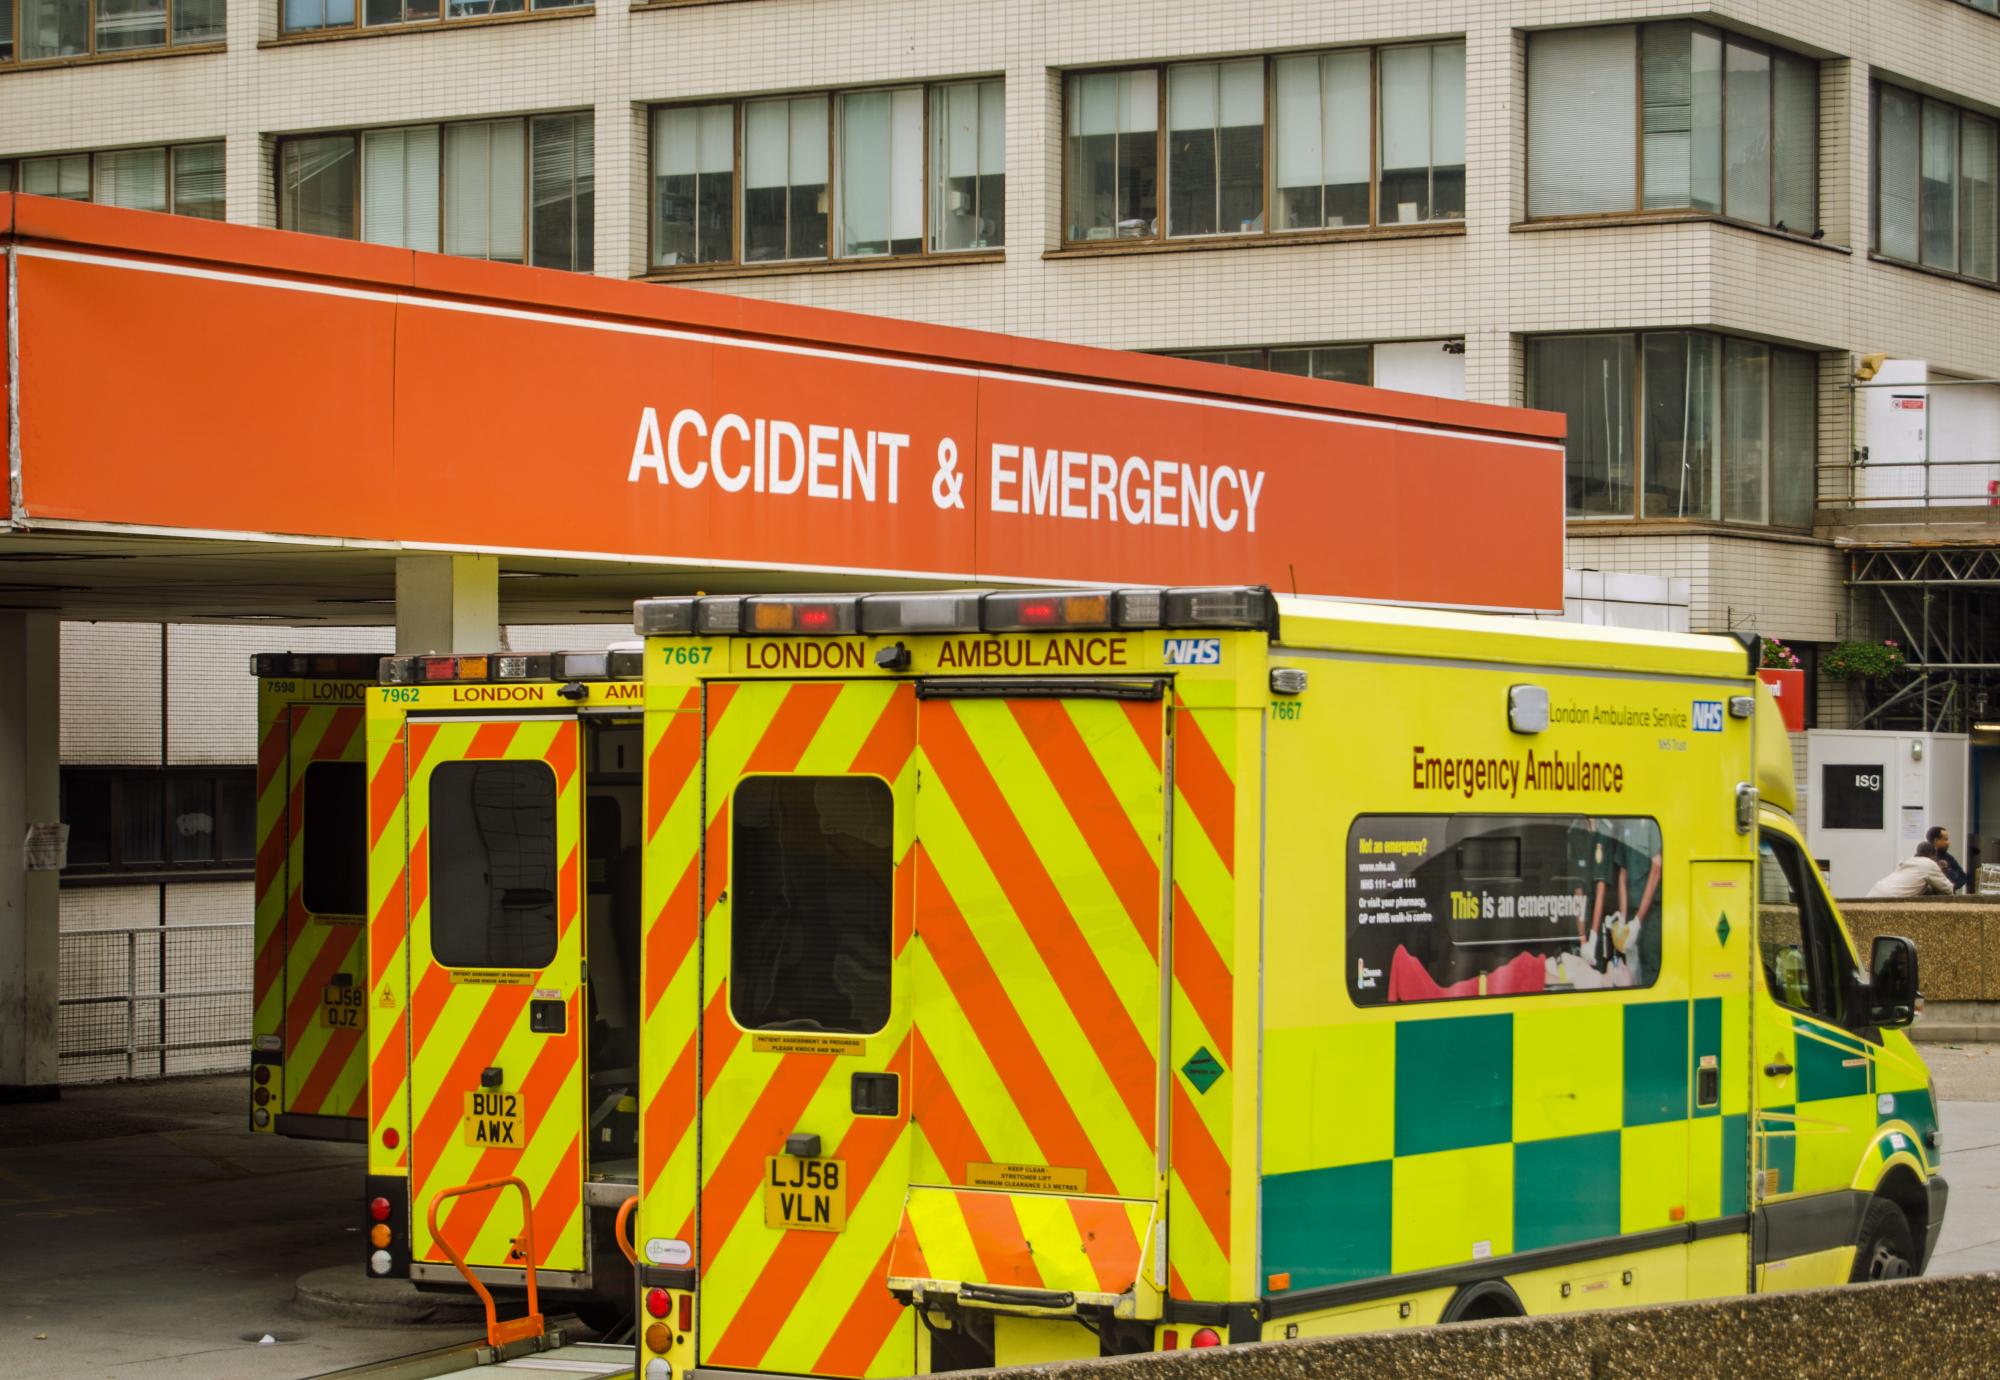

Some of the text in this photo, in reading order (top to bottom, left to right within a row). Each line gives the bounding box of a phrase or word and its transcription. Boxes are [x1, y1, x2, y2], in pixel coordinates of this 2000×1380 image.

[627, 406, 1265, 533] ACCIDENT & EMERGENCY
[663, 646, 713, 665] 7667
[746, 638, 1127, 669] LONDON AMBULANCE
[1164, 639, 1219, 664] NHS
[267, 681, 296, 695] 7598
[313, 682, 367, 699] LONDO
[381, 688, 420, 703] 7962
[453, 686, 544, 702] LONDON
[1271, 702, 1302, 720] 7667
[1549, 702, 1722, 730] London Ambulance Service NHS
[1413, 747, 1623, 799] Emergency Ambulance
[1855, 774, 1880, 791] isg
[1359, 838, 1373, 854] Not
[1384, 838, 1429, 857] emergency?
[1450, 891, 1588, 923] This is an emergency
[473, 1093, 516, 1117] BU12
[476, 1120, 514, 1143] AWX
[772, 1158, 838, 1190] LJ58
[1004, 1181, 1041, 1189] CLEARANCE
[781, 1193, 829, 1223] VLN
